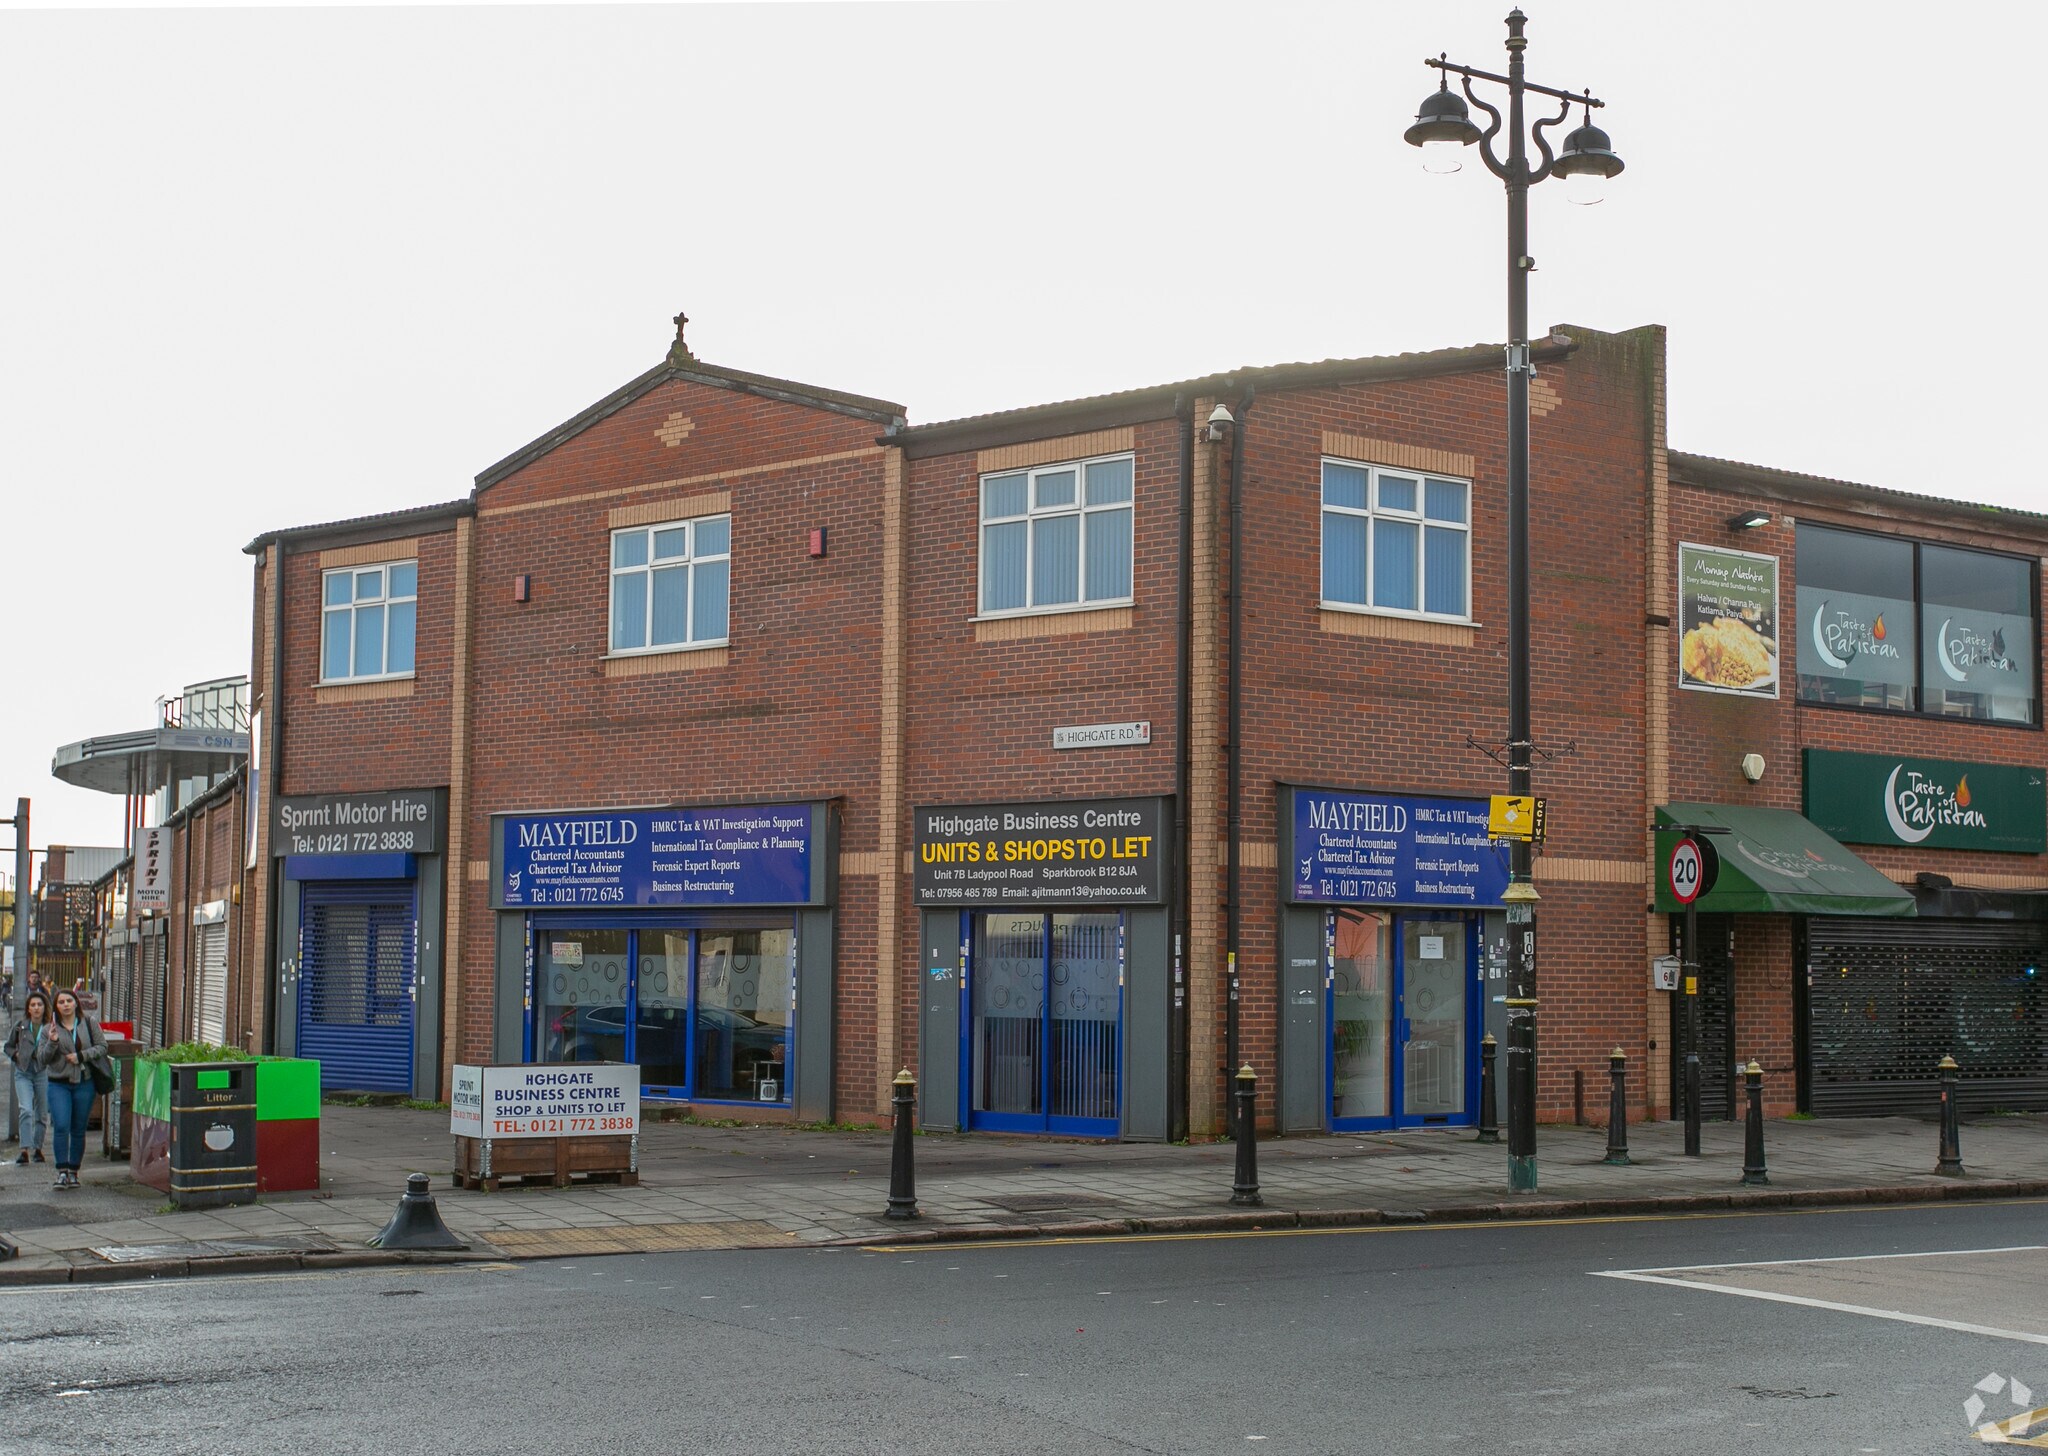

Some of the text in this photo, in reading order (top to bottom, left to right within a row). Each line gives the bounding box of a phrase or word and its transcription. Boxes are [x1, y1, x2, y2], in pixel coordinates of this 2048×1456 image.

[1694, 560, 1728, 581] Morning
[1686, 576, 1700, 584] Every
[1700, 578, 1720, 587] Saturday
[1730, 582, 1746, 591] Sunday
[1697, 593, 1717, 603] Halwa
[1723, 597, 1747, 608] Channa
[1698, 605, 1725, 617] Katlama,
[1837, 612, 1872, 641] Taste of
[1826, 624, 1899, 658] Pakistan
[1960, 627, 1992, 656] Taste of
[1950, 639, 2018, 672] Pakistan
[204, 736, 233, 747] CSN
[1068, 730, 1115, 742] HIGHGATE
[1908, 772, 1955, 810] Taste of
[281, 799, 427, 831] Sprint Motor Hire
[1309, 800, 1407, 833] MAYFIELD
[1899, 790, 1987, 828] Pakistan
[652, 816, 803, 834] HMRC Tax & VAT Investigation Support
[928, 810, 1141, 837] Highgate Business Centre
[1416, 808, 1435, 821] HMRC
[1435, 810, 1446, 822] Tax
[1447, 811, 1452, 822] &
[1452, 810, 1465, 823] VAT
[1466, 811, 1489, 829] Investiga
[519, 820, 638, 847] MAYFIELD
[1320, 833, 1396, 849] Chartered Accountants
[1416, 831, 1449, 845] International
[1451, 832, 1460, 845] Tax
[292, 831, 413, 853] Tel: 0121 772 3838
[652, 836, 804, 854] International Tax Compliance & Planning
[922, 836, 1152, 863] UNITS & SHOPS TO LET
[146, 831, 159, 886] SPRINT
[531, 849, 624, 861] Chartered Accountants
[1318, 848, 1395, 864] Chartered Tax Advisor
[529, 862, 622, 874] Chartered Tax Advisor
[653, 859, 740, 875] Forensic Expert Reports
[934, 866, 1137, 881] Unit 7B Ladypool Road Sparkbrook B12 8JA
[1324, 865, 1393, 877] www.mayfieldaccountants.com
[1416, 858, 1479, 877] Forensic Expert Reports
[1675, 858, 1696, 883] 20
[536, 876, 620, 885] www.mayfieldaccountants.com
[653, 880, 734, 894] Business Restructuring
[1341, 880, 1358, 896] 0121
[1361, 880, 1375, 896] 772
[1378, 881, 1396, 897] 6745
[555, 888, 576, 901] 0121
[580, 888, 598, 901] 772
[600, 887, 624, 901] 6745
[921, 885, 1147, 898] Tel: 07956 485 789 Email: ajitmann13@yahoo.co.uk
[1416, 881, 1475, 899] Business Restructuring
[459, 1080, 474, 1091] SPRINT
[495, 1087, 620, 1100] BUSINESS CENTRE
[207, 1093, 233, 1102] Litter
[454, 1092, 480, 1105] MOTOR HIRE
[496, 1103, 625, 1115] SHOP & UNITS TO LET
[493, 1117, 633, 1133] TEL: 0121 772 3838
